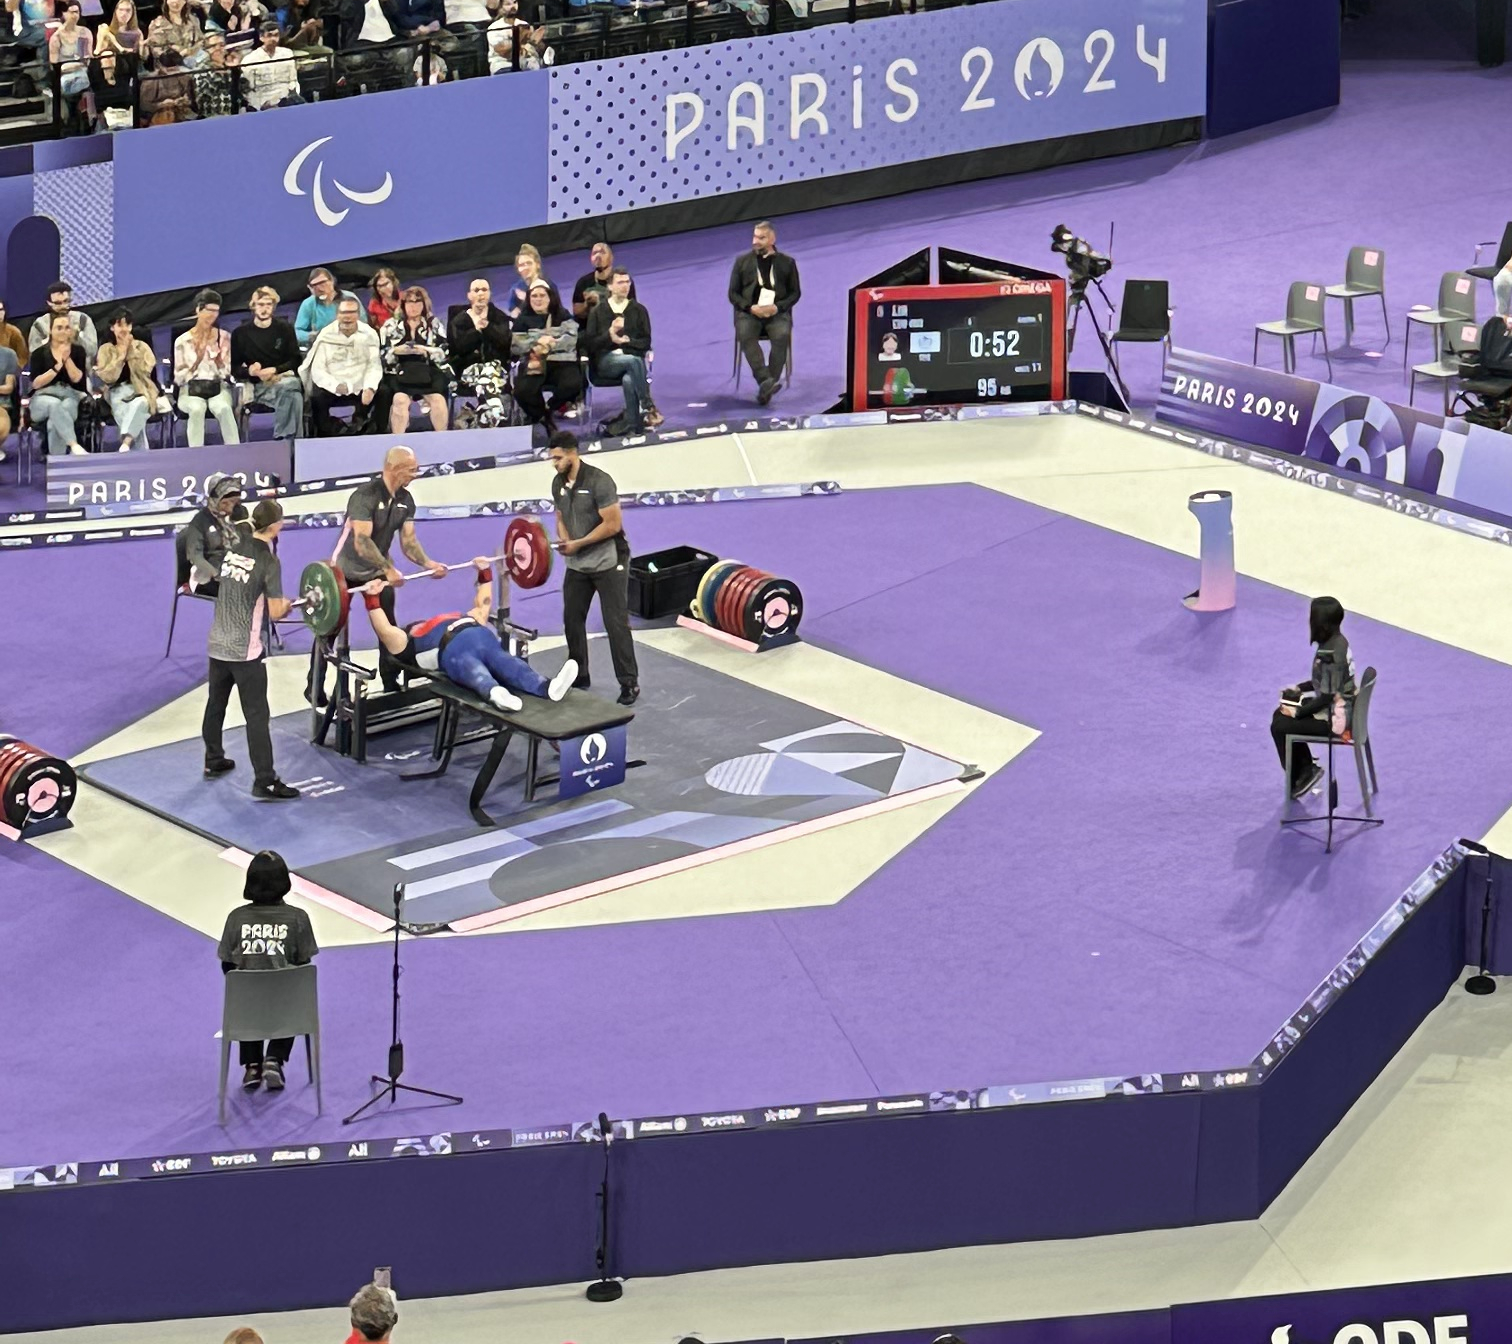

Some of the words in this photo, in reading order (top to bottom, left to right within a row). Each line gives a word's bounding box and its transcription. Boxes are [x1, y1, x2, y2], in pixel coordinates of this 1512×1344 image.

[666, 58, 919, 161] PARIS
[961, 24, 1167, 111] 2024
[970, 330, 1020, 357] 0:52
[1173, 374, 1235, 408] PARIS
[1242, 392, 1299, 426] 2024
[68, 478, 167, 505] PARIS
